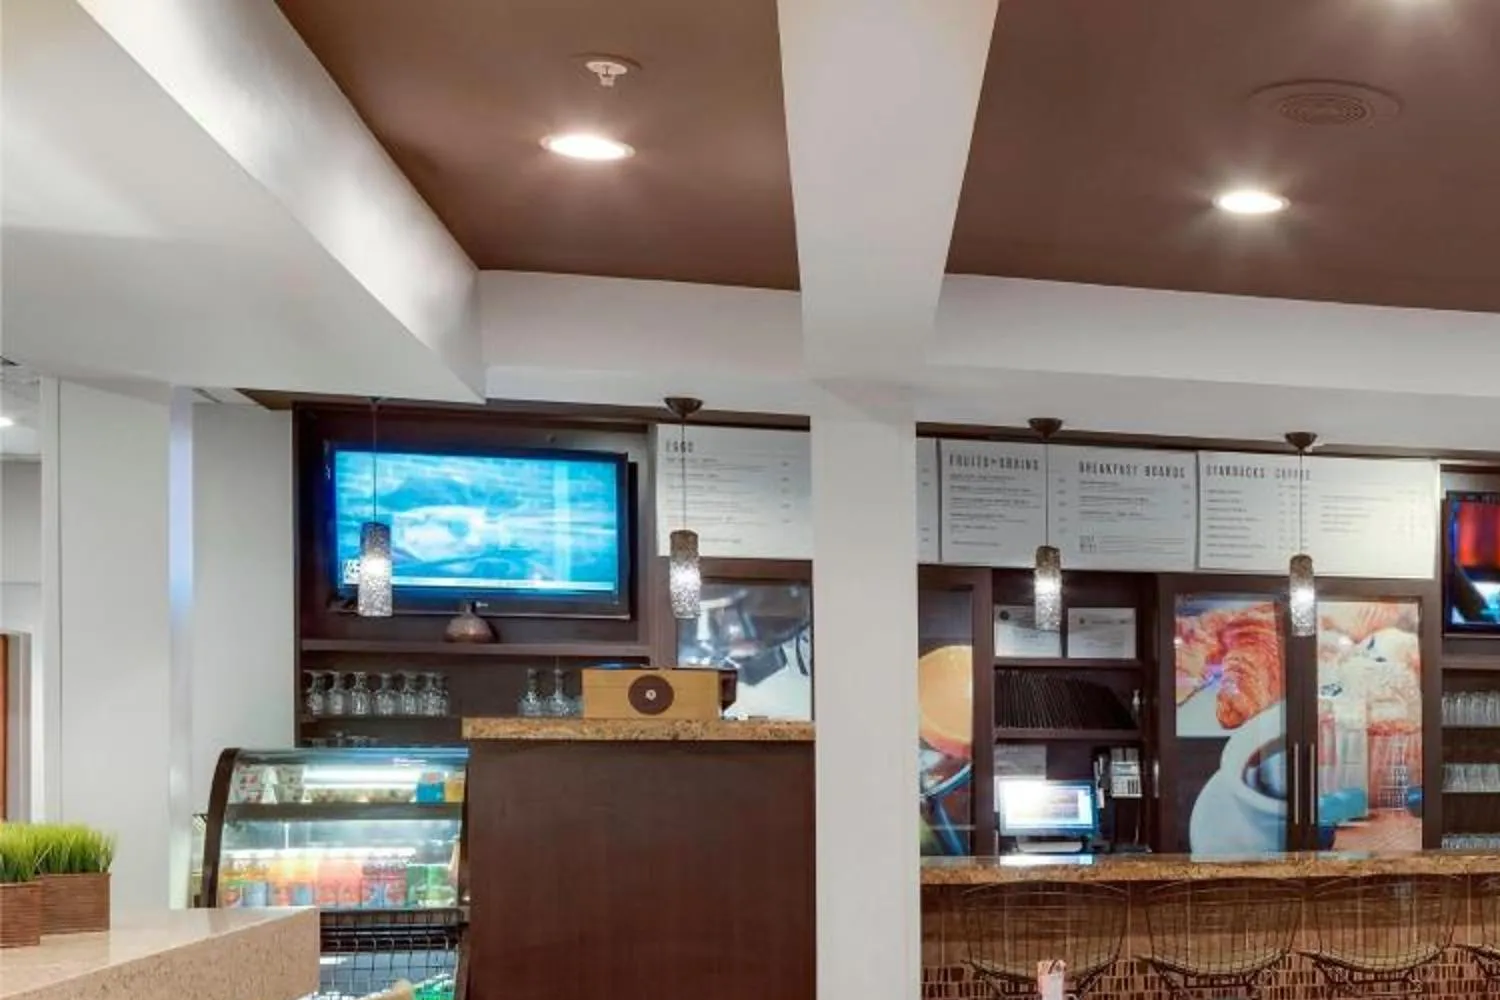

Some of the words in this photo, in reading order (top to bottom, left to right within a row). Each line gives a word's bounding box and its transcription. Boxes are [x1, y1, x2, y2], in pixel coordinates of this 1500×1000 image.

[949, 454, 989, 467] FRUITS
[1079, 460, 1138, 476] BREAKFAST
[1144, 465, 1185, 479] BOARDS
[1206, 464, 1265, 479] STARBUCKS
